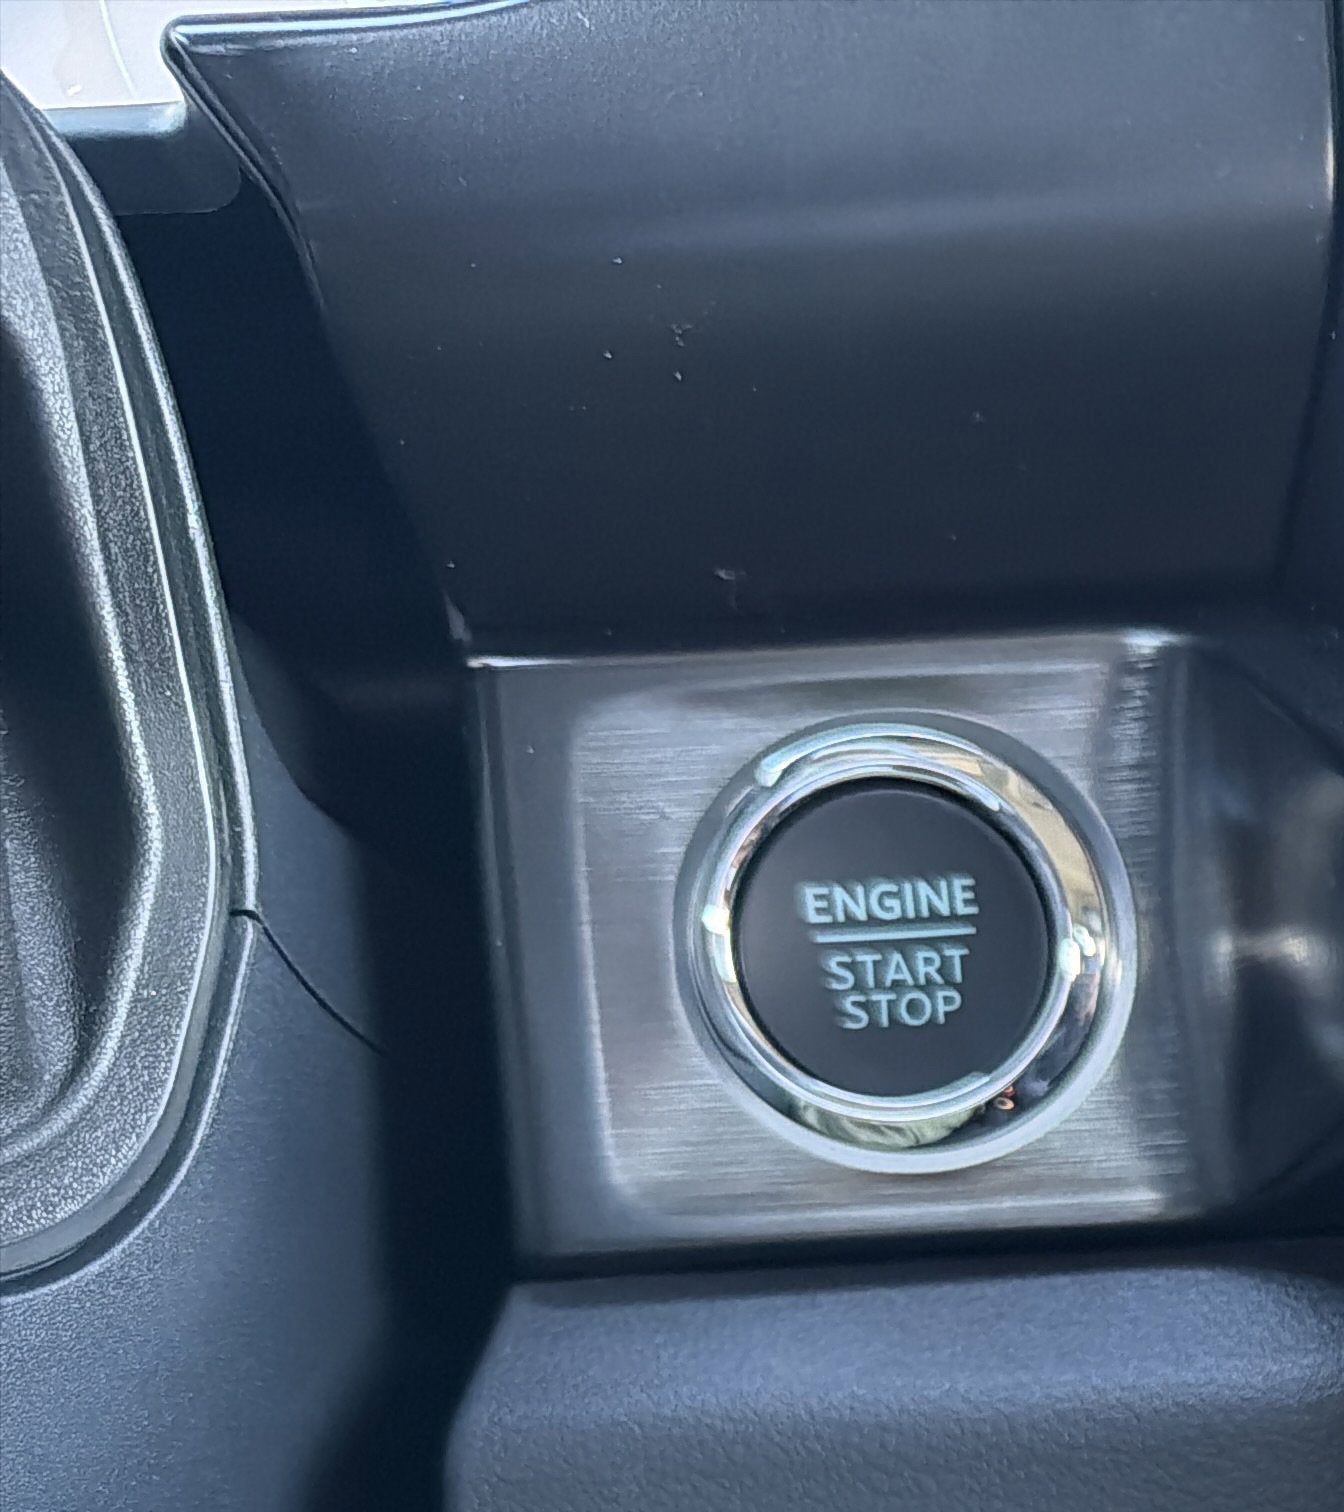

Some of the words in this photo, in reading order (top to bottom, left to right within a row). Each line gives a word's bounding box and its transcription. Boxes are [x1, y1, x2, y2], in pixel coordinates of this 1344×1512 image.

[802, 877, 979, 925] ENGINE
[823, 946, 971, 991] START
[838, 989, 963, 1030] STOP
